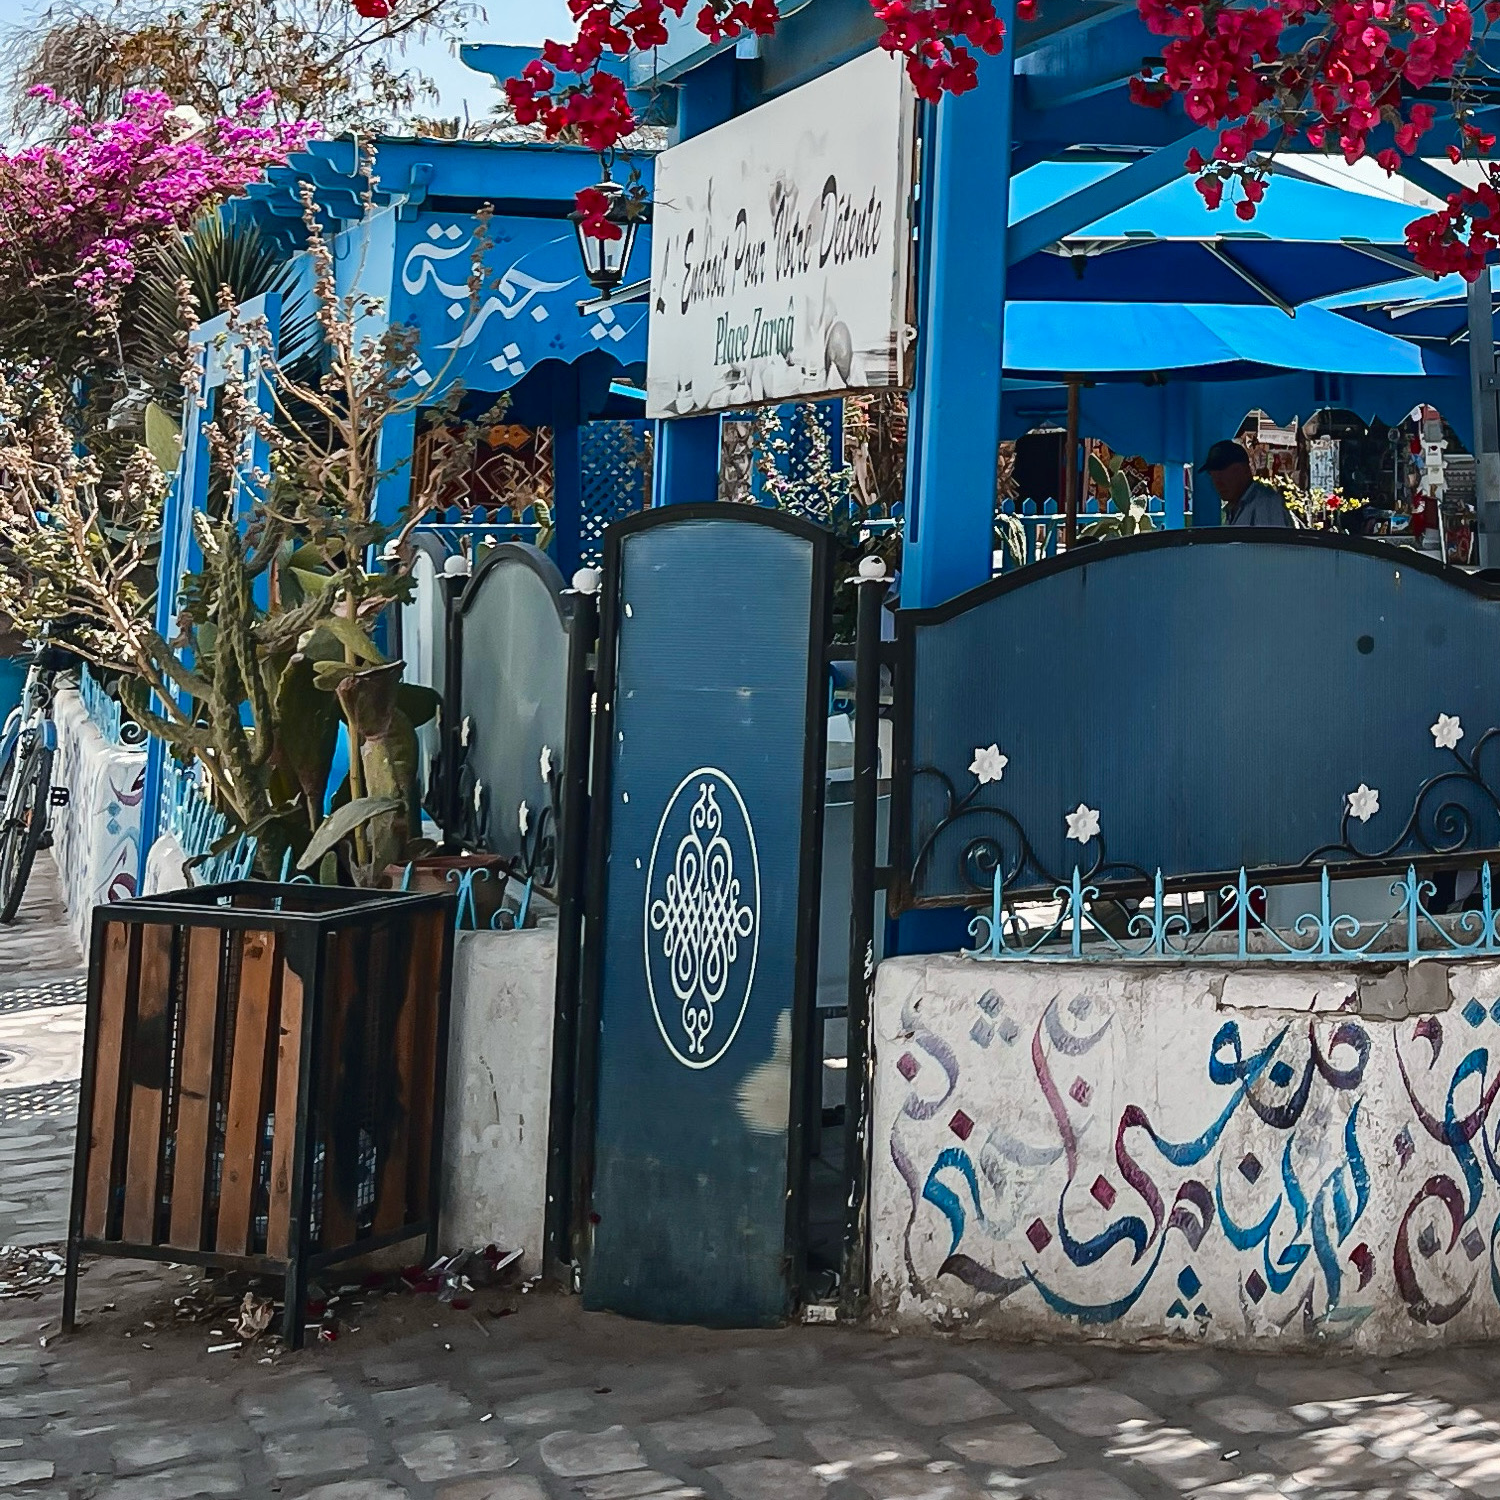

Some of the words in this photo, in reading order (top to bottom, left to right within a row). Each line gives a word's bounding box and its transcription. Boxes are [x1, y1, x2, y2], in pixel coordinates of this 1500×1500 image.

[732, 208, 766, 295] Pour
[774, 193, 812, 282] Votre
[819, 174, 882, 268] Détente
[714, 311, 749, 366] Place
